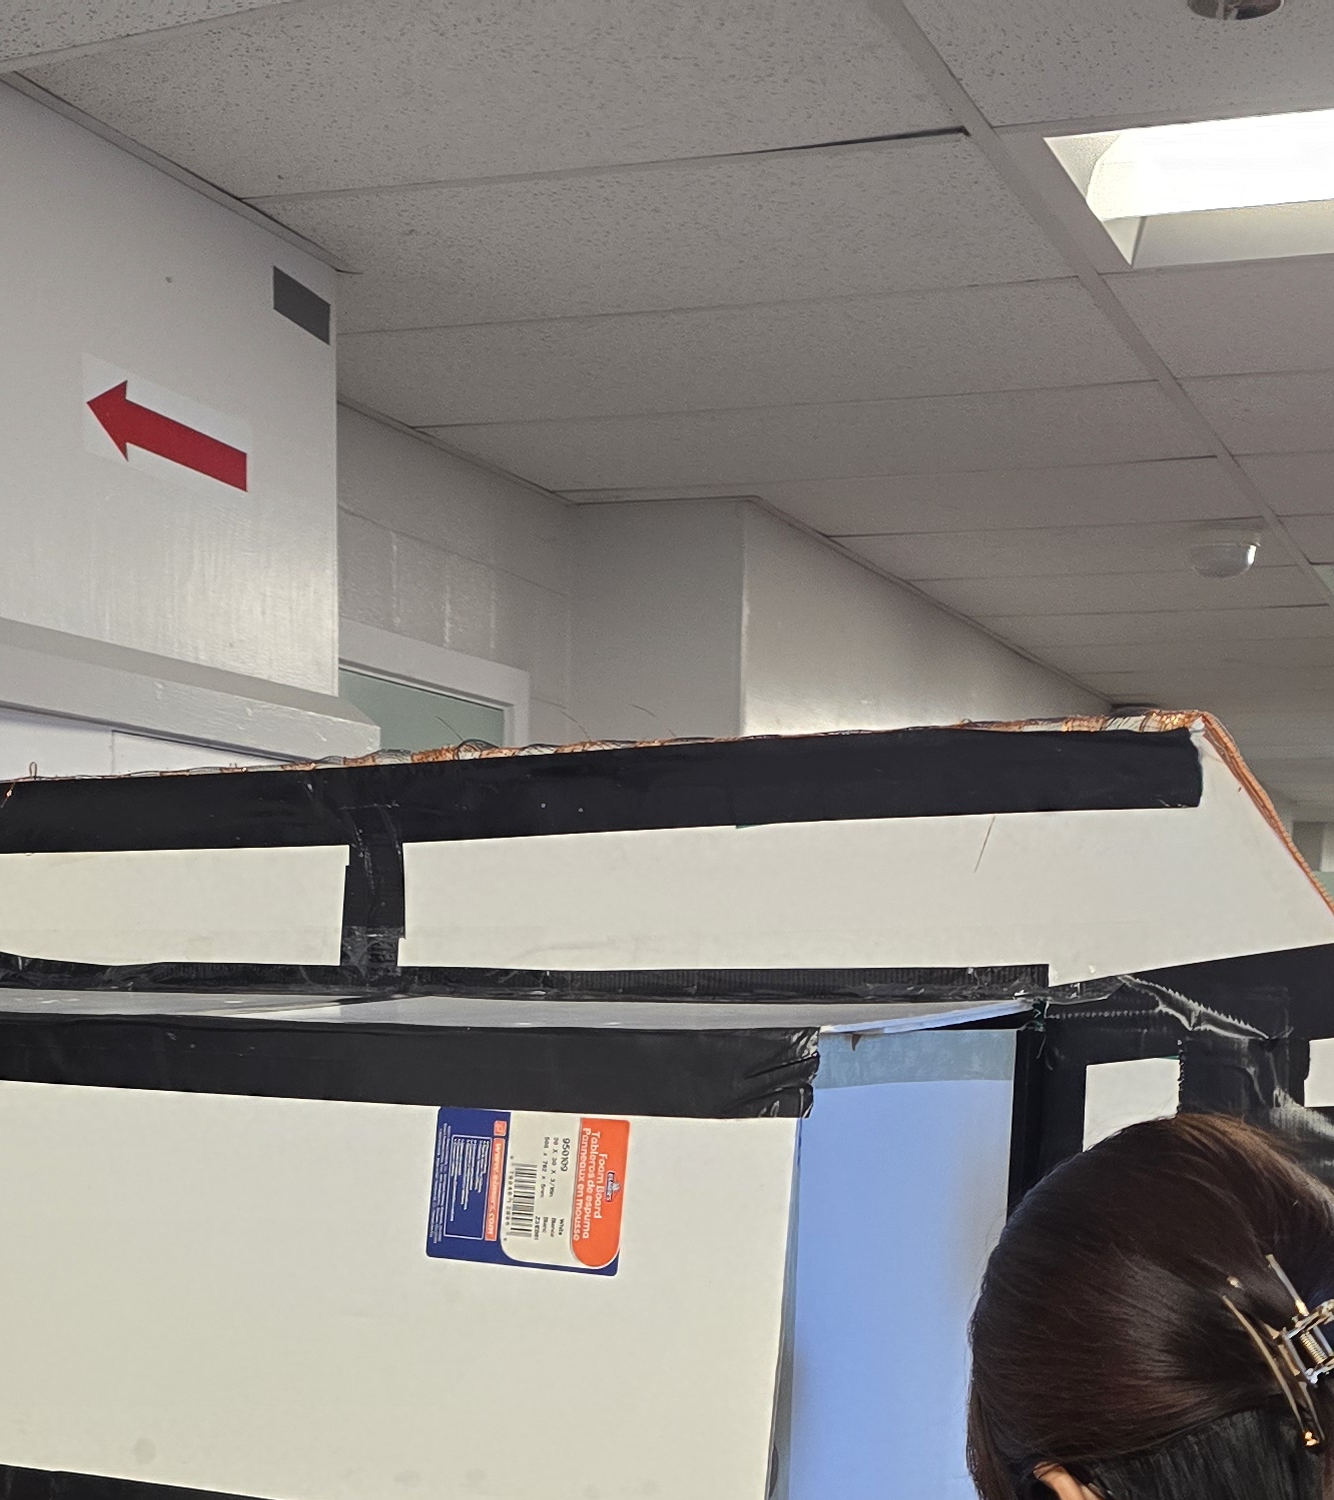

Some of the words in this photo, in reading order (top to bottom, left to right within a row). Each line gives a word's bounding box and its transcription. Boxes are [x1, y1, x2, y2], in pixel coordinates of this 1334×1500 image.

[561, 1138, 570, 1172] 950109
[578, 1128, 591, 1182] Panneaux
[589, 1131, 600, 1179] Tableros
[597, 1154, 607, 1183] Foam
[577, 1184, 585, 1197] en
[587, 1180, 596, 1193] de
[594, 1186, 604, 1218] Board
[573, 1199, 583, 1240] mousse
[582, 1195, 592, 1238] espuma
